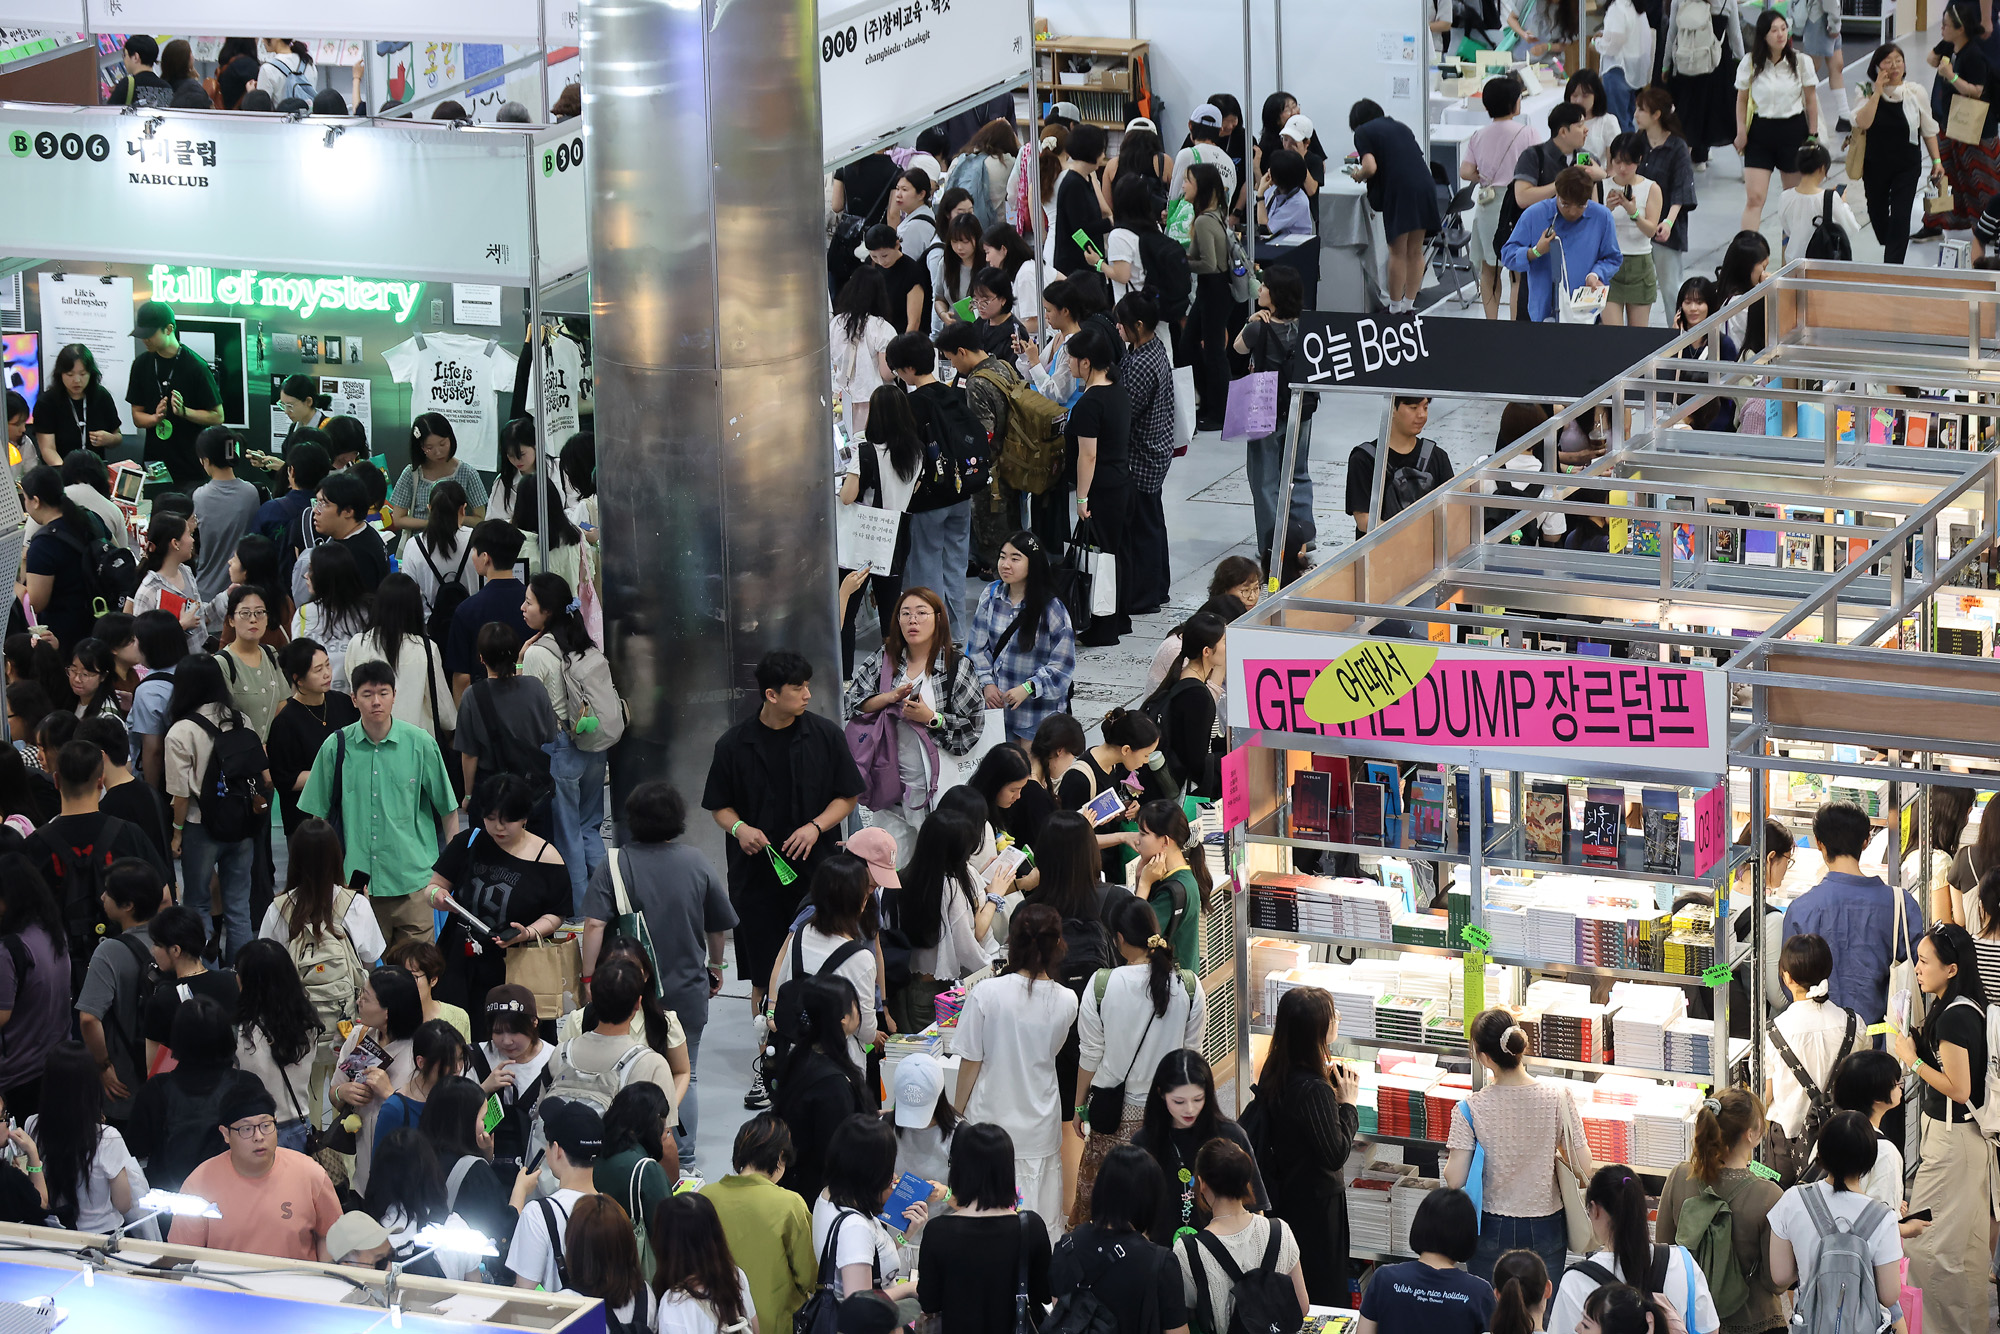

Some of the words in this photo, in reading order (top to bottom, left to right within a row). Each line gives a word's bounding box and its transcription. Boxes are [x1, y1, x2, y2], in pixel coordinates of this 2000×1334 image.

[129, 173, 209, 187] NABICLUB
[61, 297, 73, 305] full
[81, 298, 109, 309] mystery
[74, 289, 88, 298] Life
[89, 289, 95, 298] is
[149, 264, 215, 303] full
[217, 269, 258, 306] of
[259, 276, 421, 323] mystery
[1303, 325, 1355, 382] 오늘
[1357, 315, 1429, 372] Best
[434, 361, 461, 381] Life
[462, 366, 473, 381] is
[443, 379, 457, 387] full
[457, 379, 465, 388] of
[431, 386, 476, 405] mystery
[1336, 643, 1414, 707] 어때서
[1412, 670, 1535, 737] DUMP
[1544, 666, 1695, 742] 장르덤프
[1698, 810, 1710, 853] 03
[281, 1202, 293, 1219] S
[1393, 1283, 1413, 1294] Wish
[1413, 1288, 1426, 1297] for
[1427, 1290, 1441, 1298] nice
[1442, 1291, 1469, 1303] holiday
